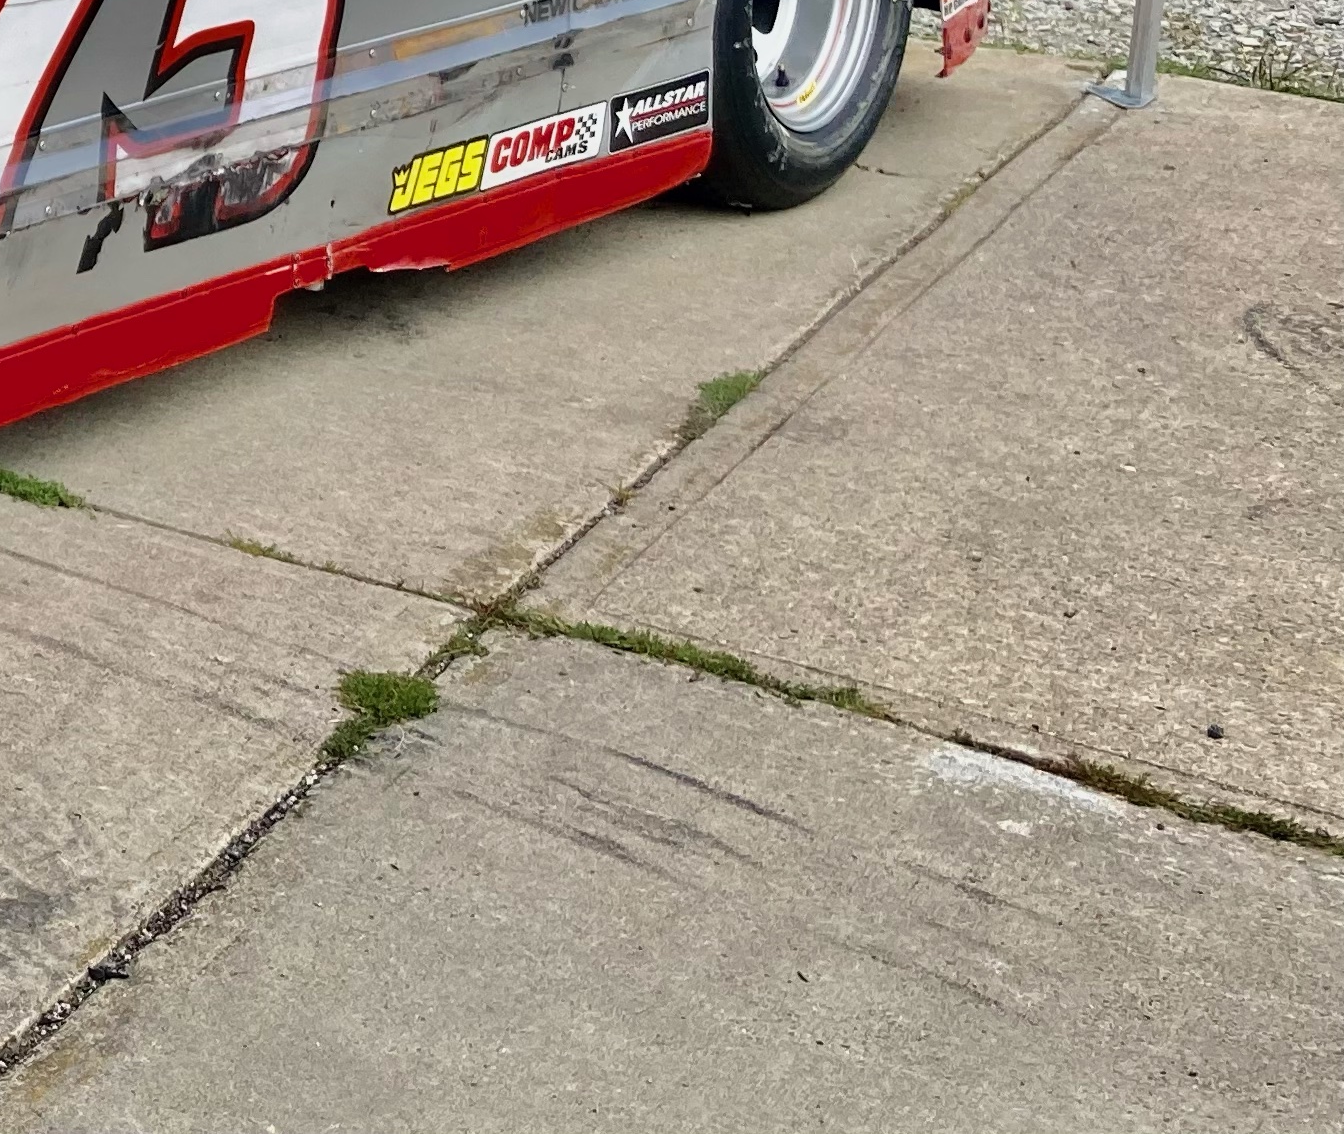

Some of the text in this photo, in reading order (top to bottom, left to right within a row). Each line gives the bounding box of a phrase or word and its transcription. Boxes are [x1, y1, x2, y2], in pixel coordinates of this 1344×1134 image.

[631, 80, 706, 116] ALLSTAR
[632, 102, 707, 131] PERFORMANCE
[490, 118, 576, 174] COMP
[545, 140, 589, 163] CAMS
[391, 137, 488, 212] JEGS
